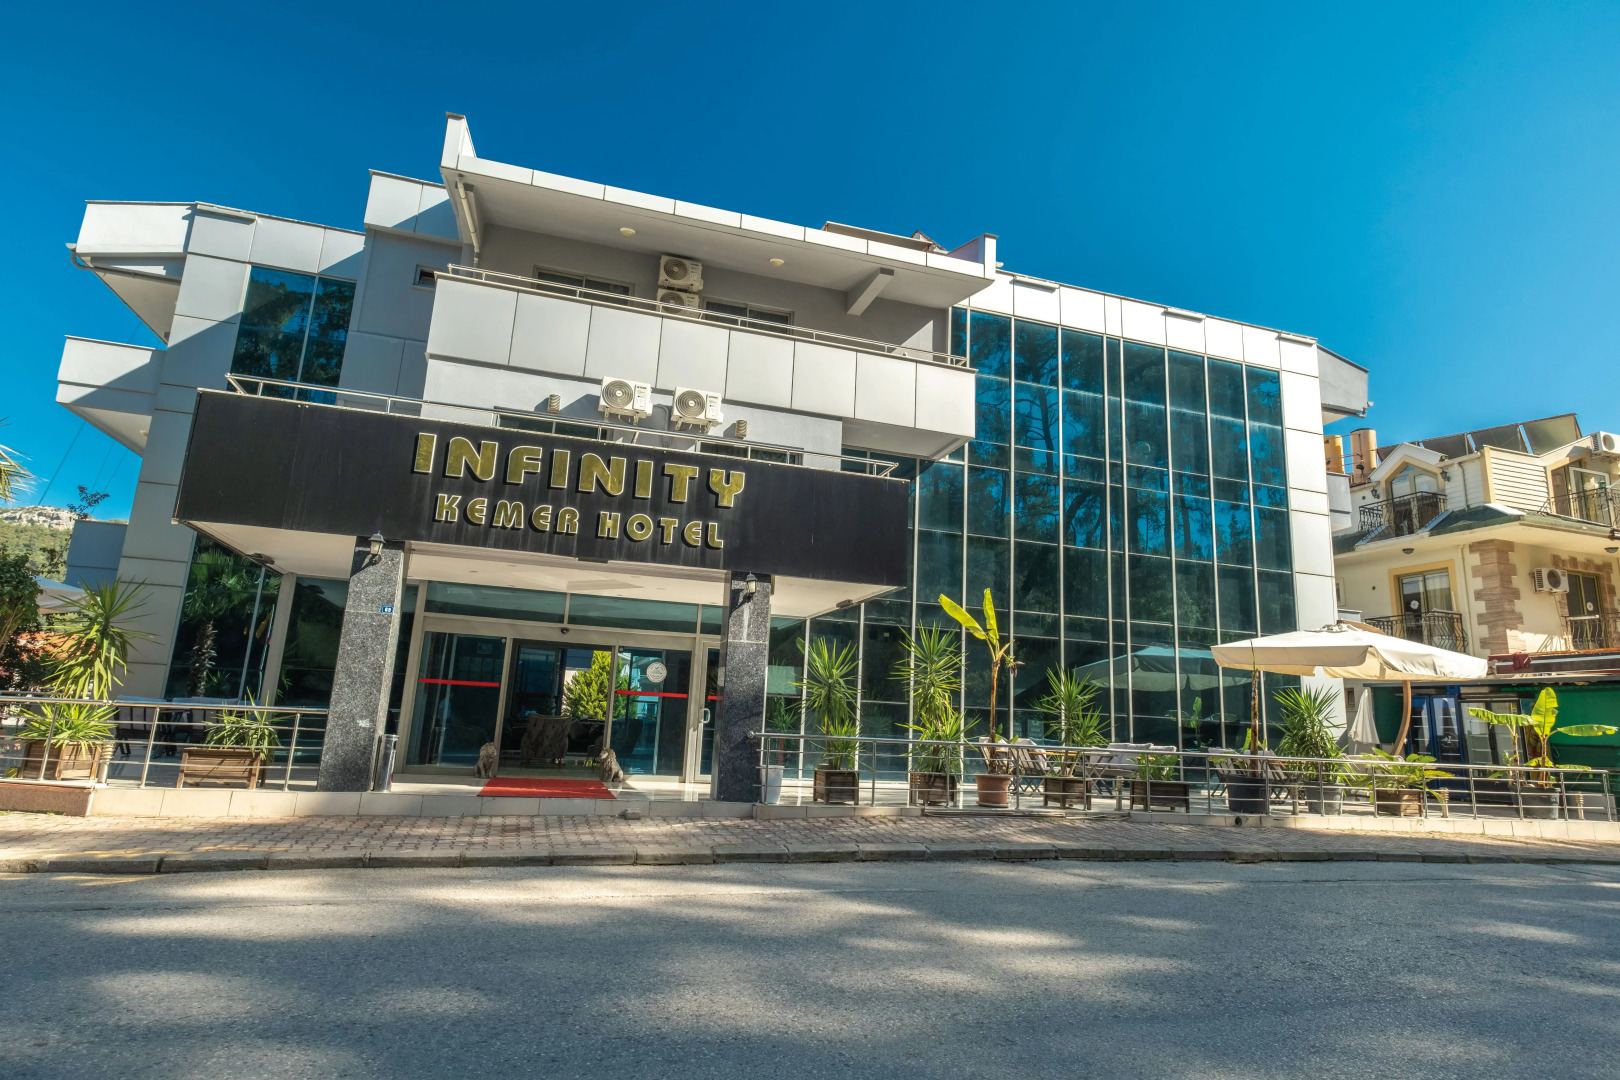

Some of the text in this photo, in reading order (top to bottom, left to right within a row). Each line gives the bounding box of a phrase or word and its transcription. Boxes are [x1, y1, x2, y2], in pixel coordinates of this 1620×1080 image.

[414, 432, 745, 508] INFINITY
[434, 493, 724, 548] KEMER HOTEL
